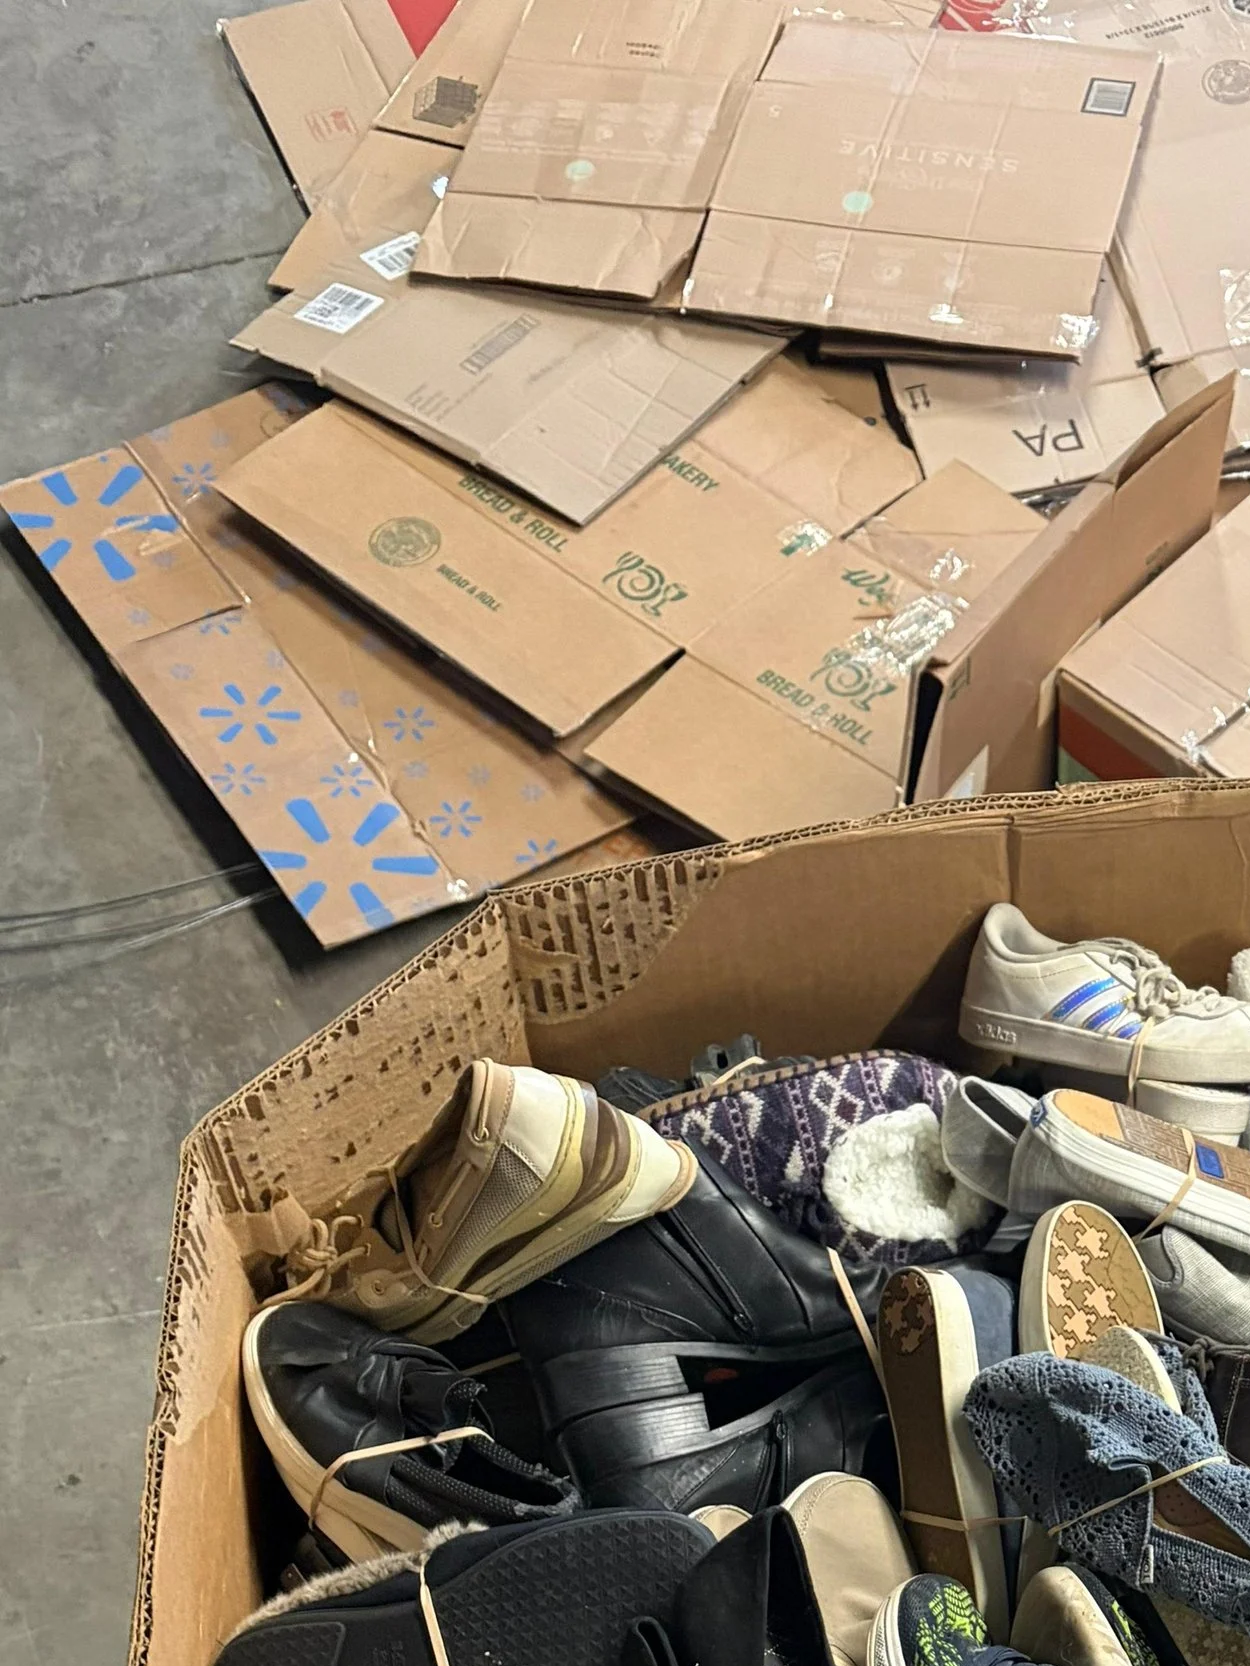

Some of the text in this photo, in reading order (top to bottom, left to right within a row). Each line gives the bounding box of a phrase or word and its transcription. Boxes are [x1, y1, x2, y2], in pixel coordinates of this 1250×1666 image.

[840, 139, 1019, 172] SENSITIVE
[1012, 418, 1084, 457] PA
[664, 455, 719, 492] AKERY
[458, 474, 569, 553] BREAD & ROLL
[475, 591, 502, 612] ROLL
[756, 669, 814, 708] BREAD
[829, 712, 874, 745] ROLL
